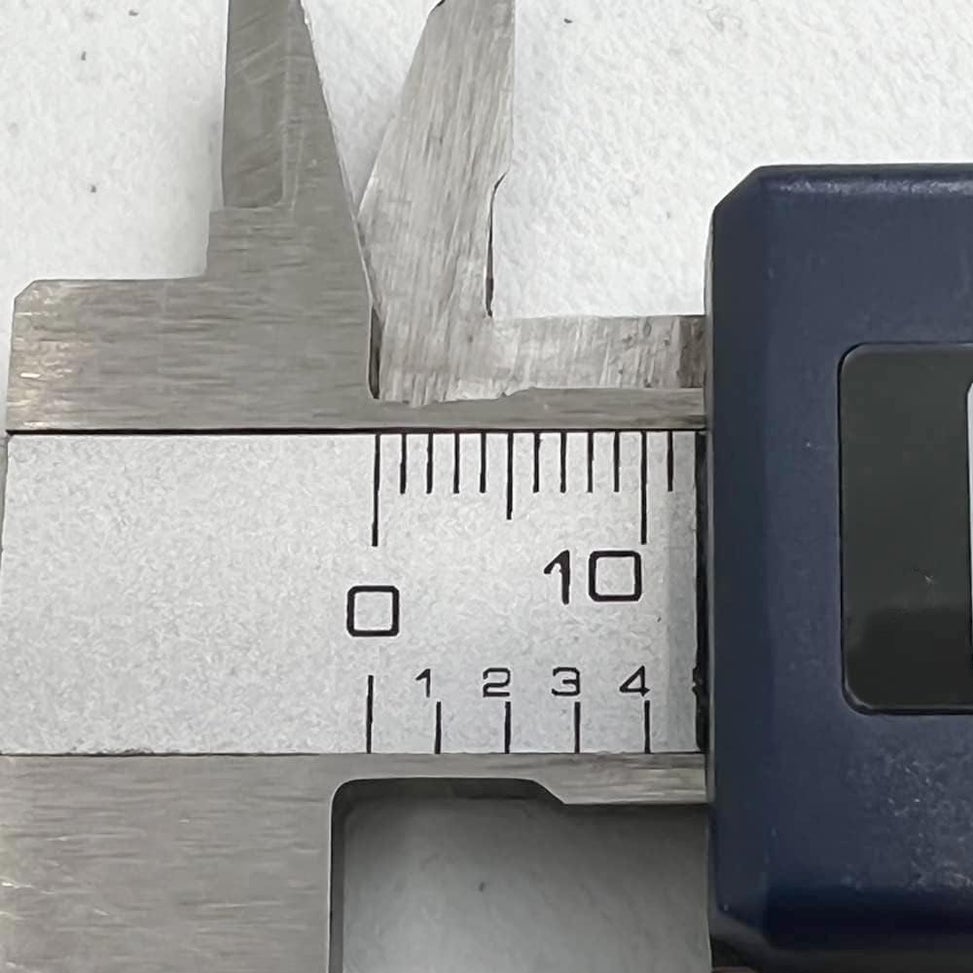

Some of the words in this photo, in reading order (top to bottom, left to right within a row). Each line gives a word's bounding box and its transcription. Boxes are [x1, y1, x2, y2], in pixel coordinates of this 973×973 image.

[543, 549, 642, 604] 10
[346, 585, 400, 637] 0
[415, 668, 432, 698] 1
[482, 667, 511, 697] 2
[551, 666, 581, 697] 3
[619, 665, 650, 697] 4
